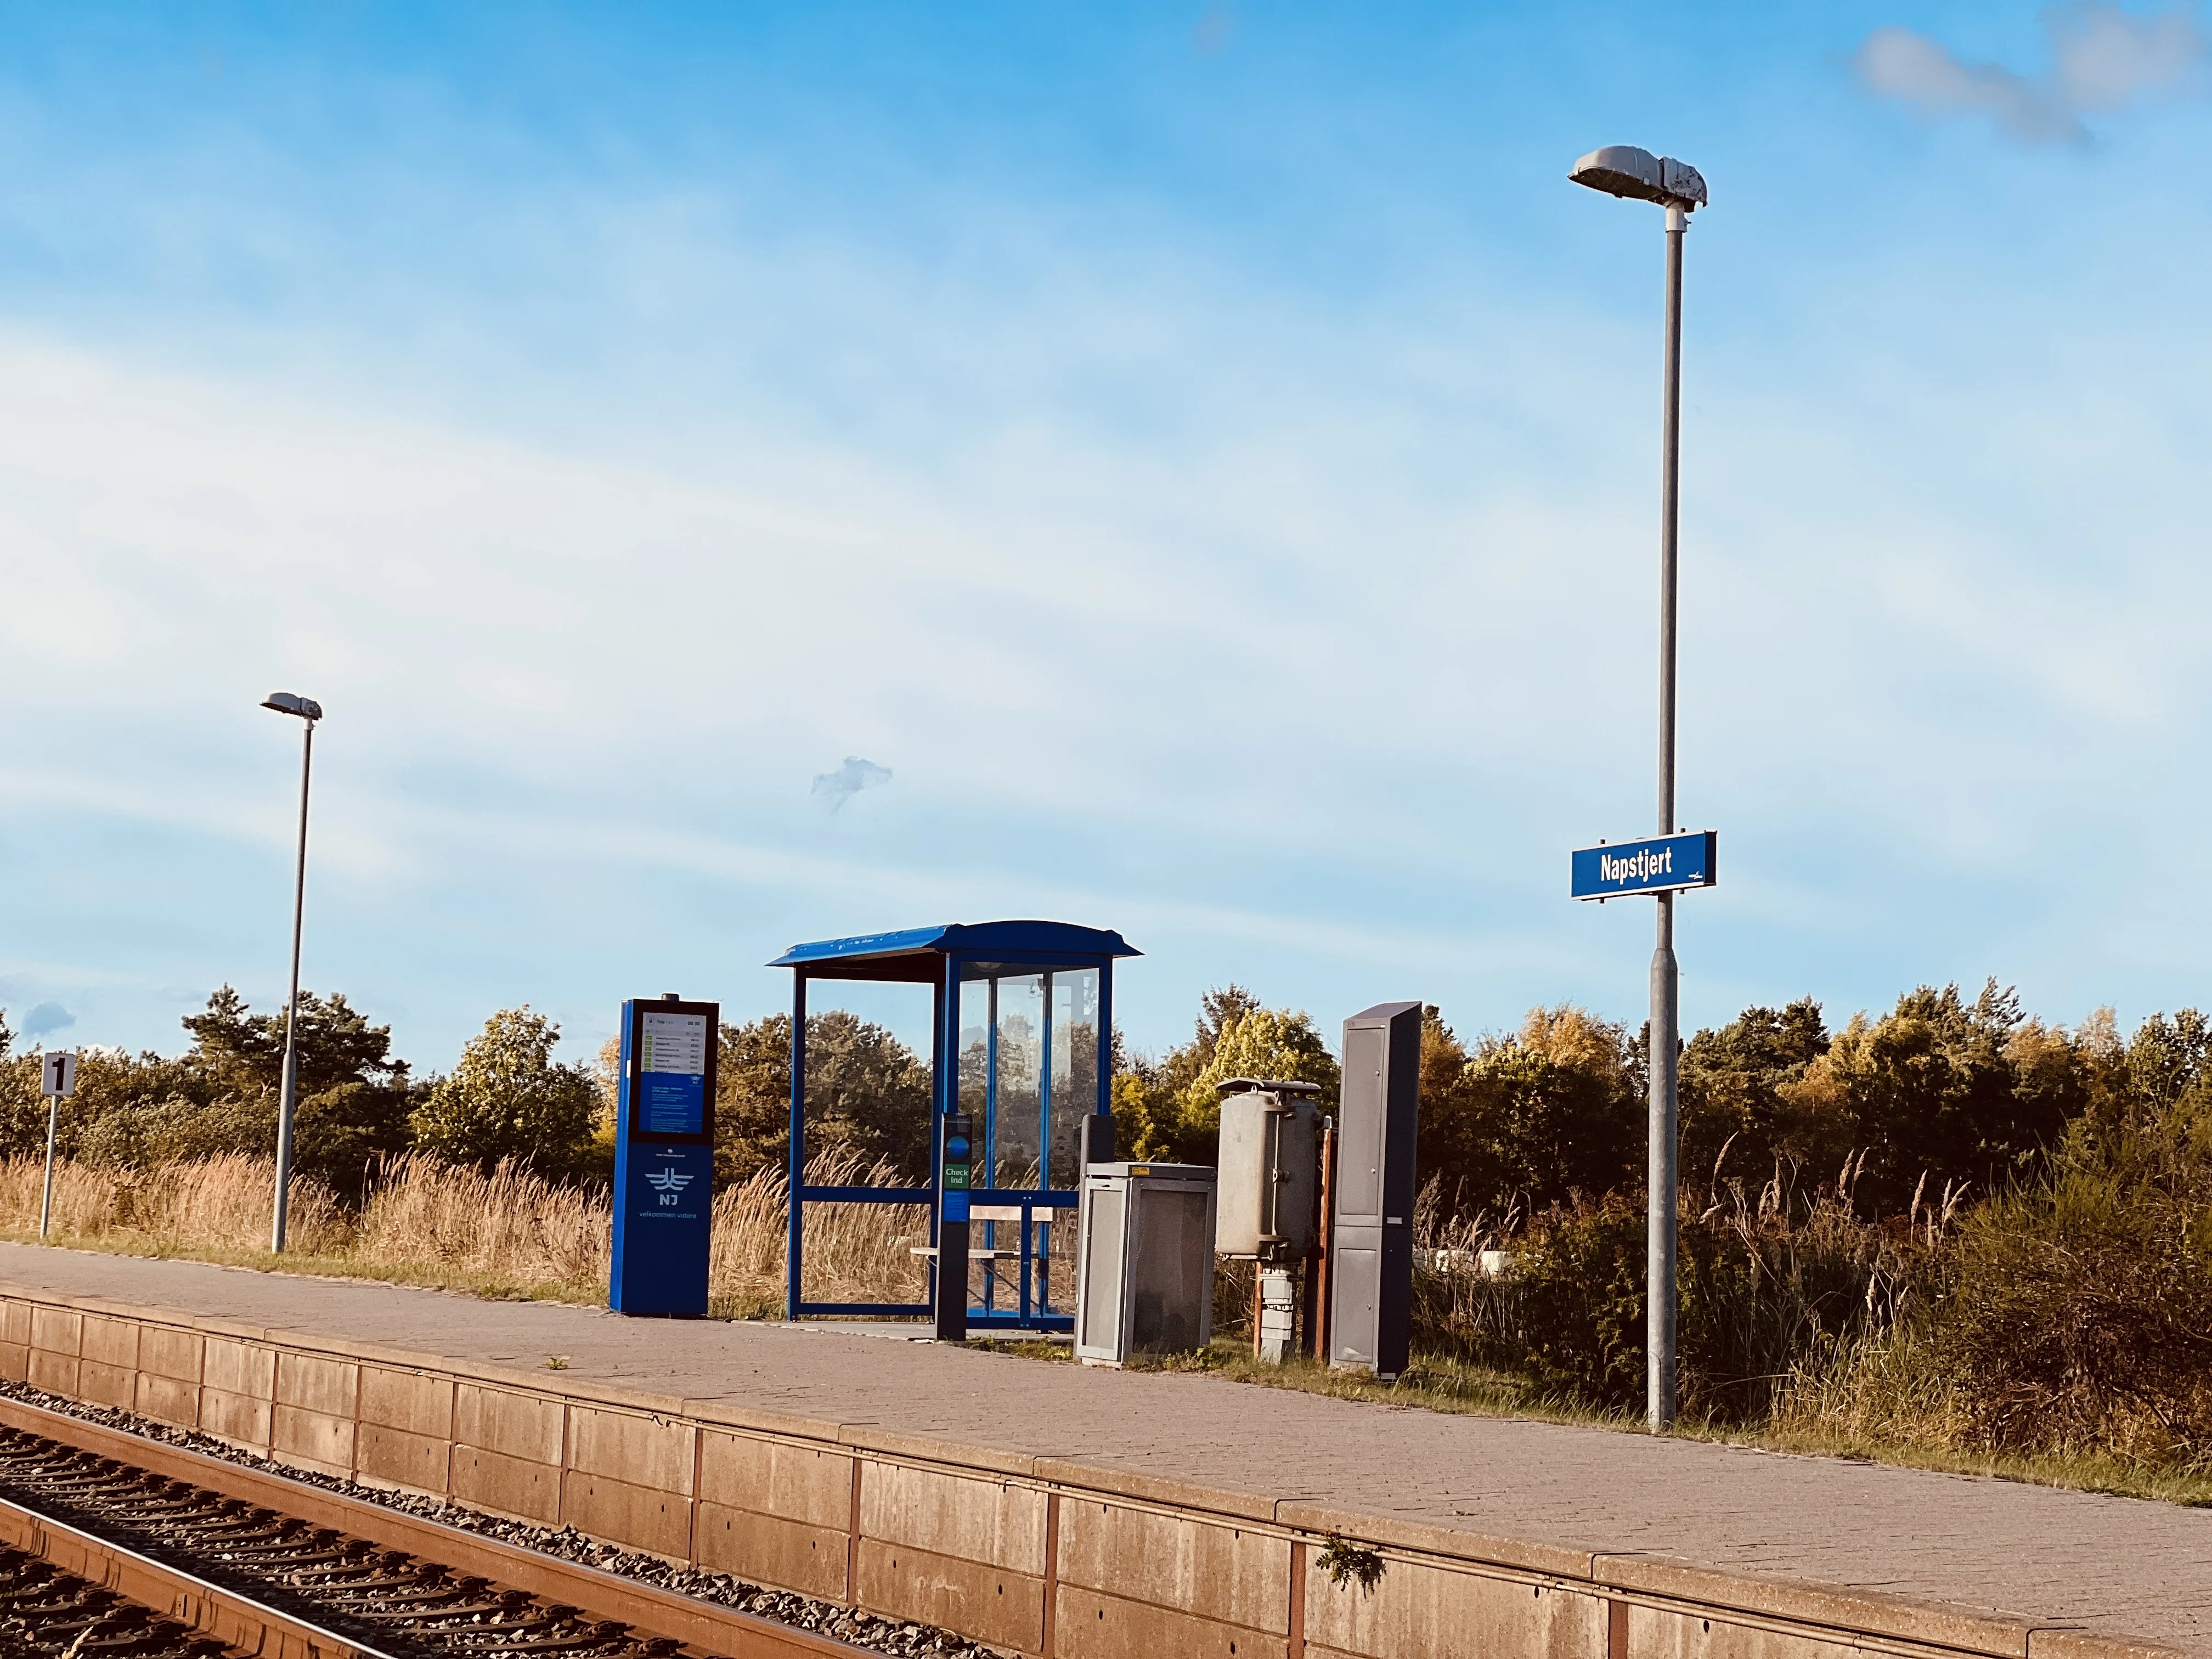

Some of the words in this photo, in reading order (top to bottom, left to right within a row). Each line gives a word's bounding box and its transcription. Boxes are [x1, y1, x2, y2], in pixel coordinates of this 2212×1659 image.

[1600, 847, 1672, 885] Napstjert
[52, 1057, 65, 1091] 1
[659, 1194, 678, 1205] NJ
